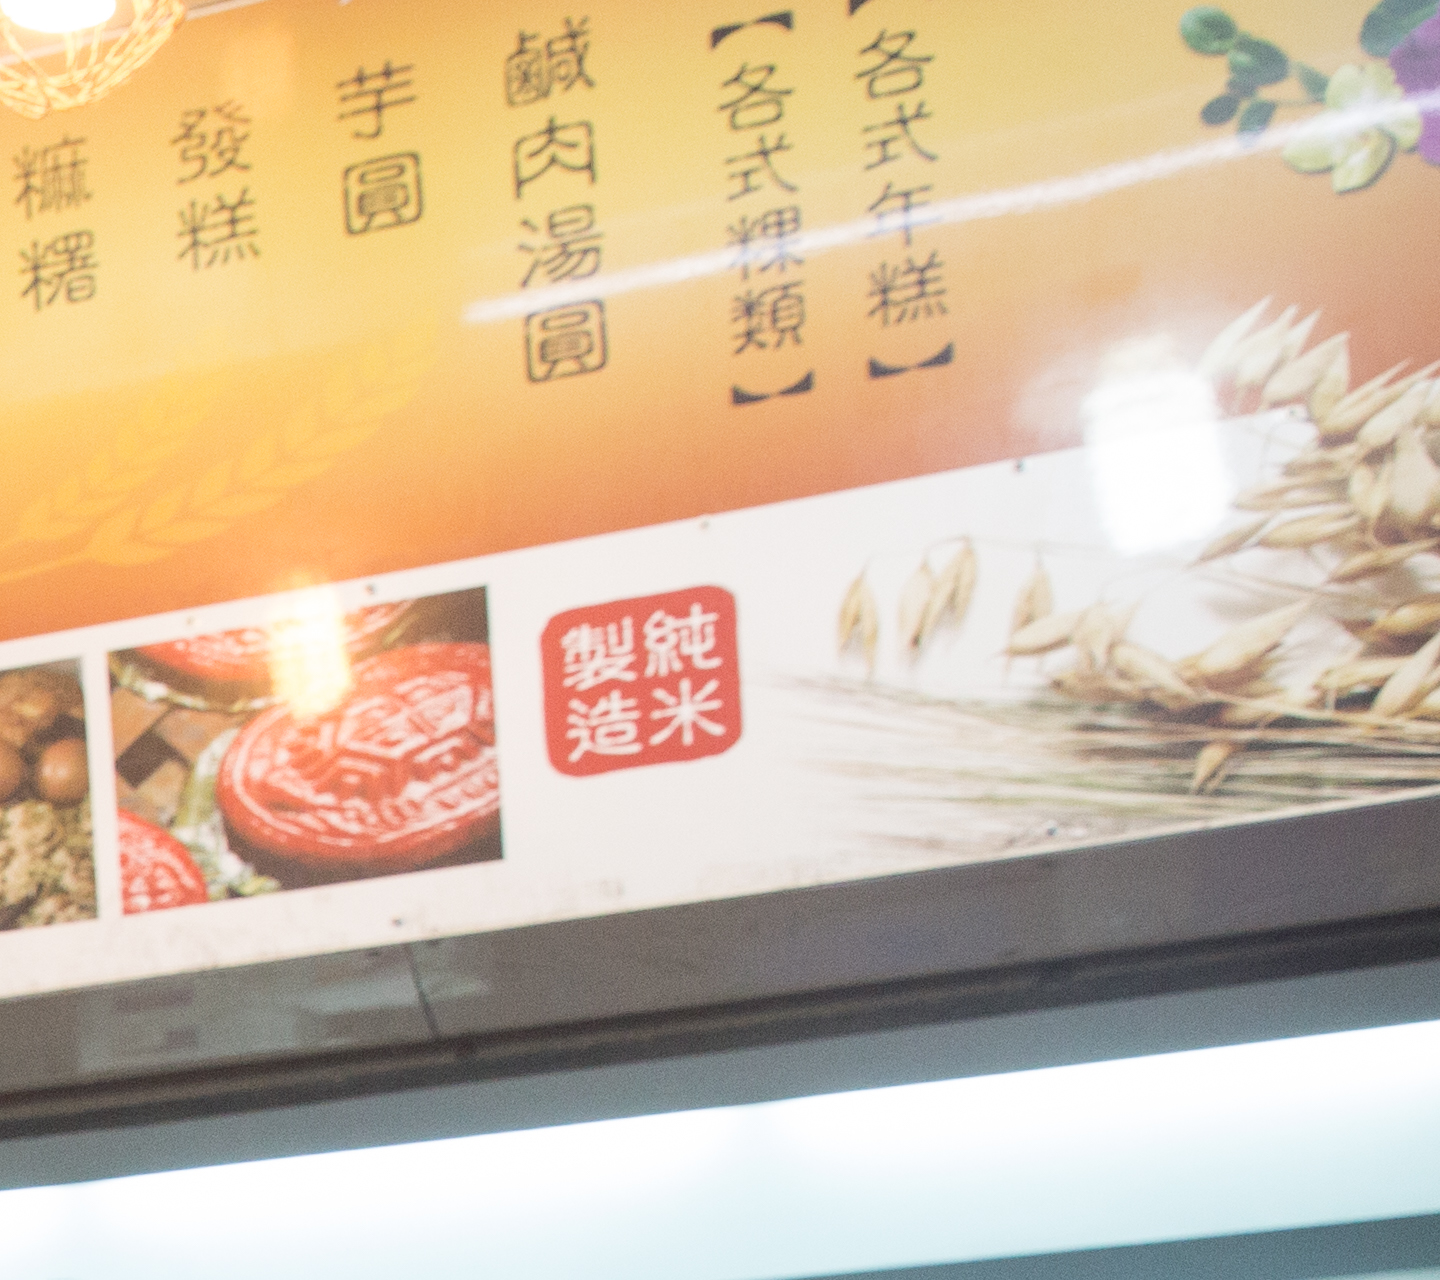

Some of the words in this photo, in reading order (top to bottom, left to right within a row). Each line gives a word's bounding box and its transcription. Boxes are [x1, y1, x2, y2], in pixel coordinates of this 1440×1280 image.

[170, 98, 261, 273] 發糕
[335, 59, 425, 237] 芋圓
[503, 15, 610, 384] 鹹肉湯圓
[559, 616, 644, 764] 製造
[642, 602, 727, 748] 純米
